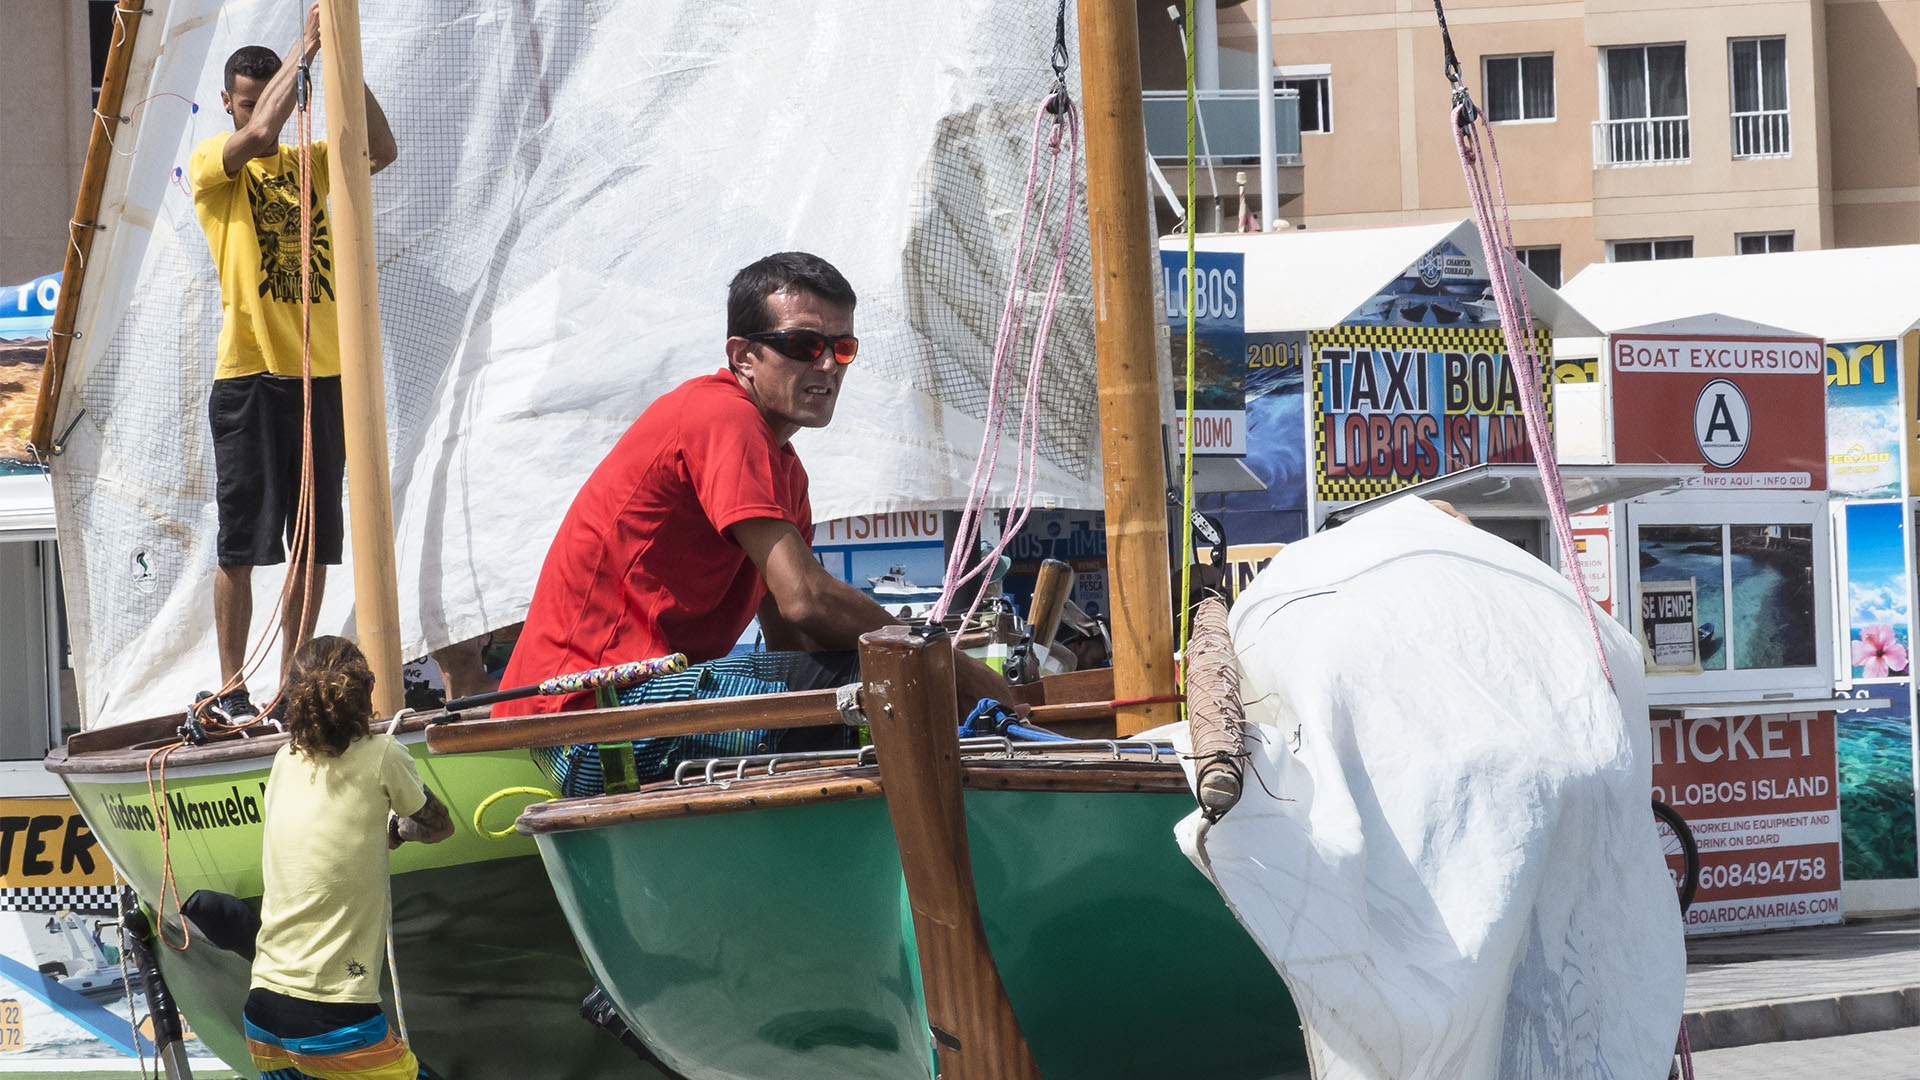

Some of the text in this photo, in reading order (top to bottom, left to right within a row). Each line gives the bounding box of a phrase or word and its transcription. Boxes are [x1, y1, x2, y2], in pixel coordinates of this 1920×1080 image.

[1164, 266, 1238, 319] LOBOS
[1247, 342, 1302, 369] 2001
[1618, 344, 1819, 370] BOAT EXCURSION
[1320, 349, 1430, 413] TAXI
[1704, 393, 1741, 442] A
[1325, 414, 1439, 478] LOBOS
[1703, 476, 1727, 486] INFO
[1764, 477, 1787, 485] INFO
[829, 510, 938, 540] FISHING
[1642, 594, 1692, 619] SE VENDE
[1651, 709, 1819, 765] TICKET
[1672, 781, 1746, 806] LOBOS
[1752, 775, 1829, 800] ISLAND
[101, 792, 156, 832] Isidoro
[166, 785, 262, 831] Manuela
[1753, 816, 1808, 829] EQUIPMENT
[1810, 815, 1830, 825] AND
[1728, 836, 1743, 847] ON
[1746, 833, 1780, 845] BOARD
[1699, 856, 1827, 890] 608494758
[5, 1006, 19, 1025] 22
[7, 1028, 20, 1046] 72
